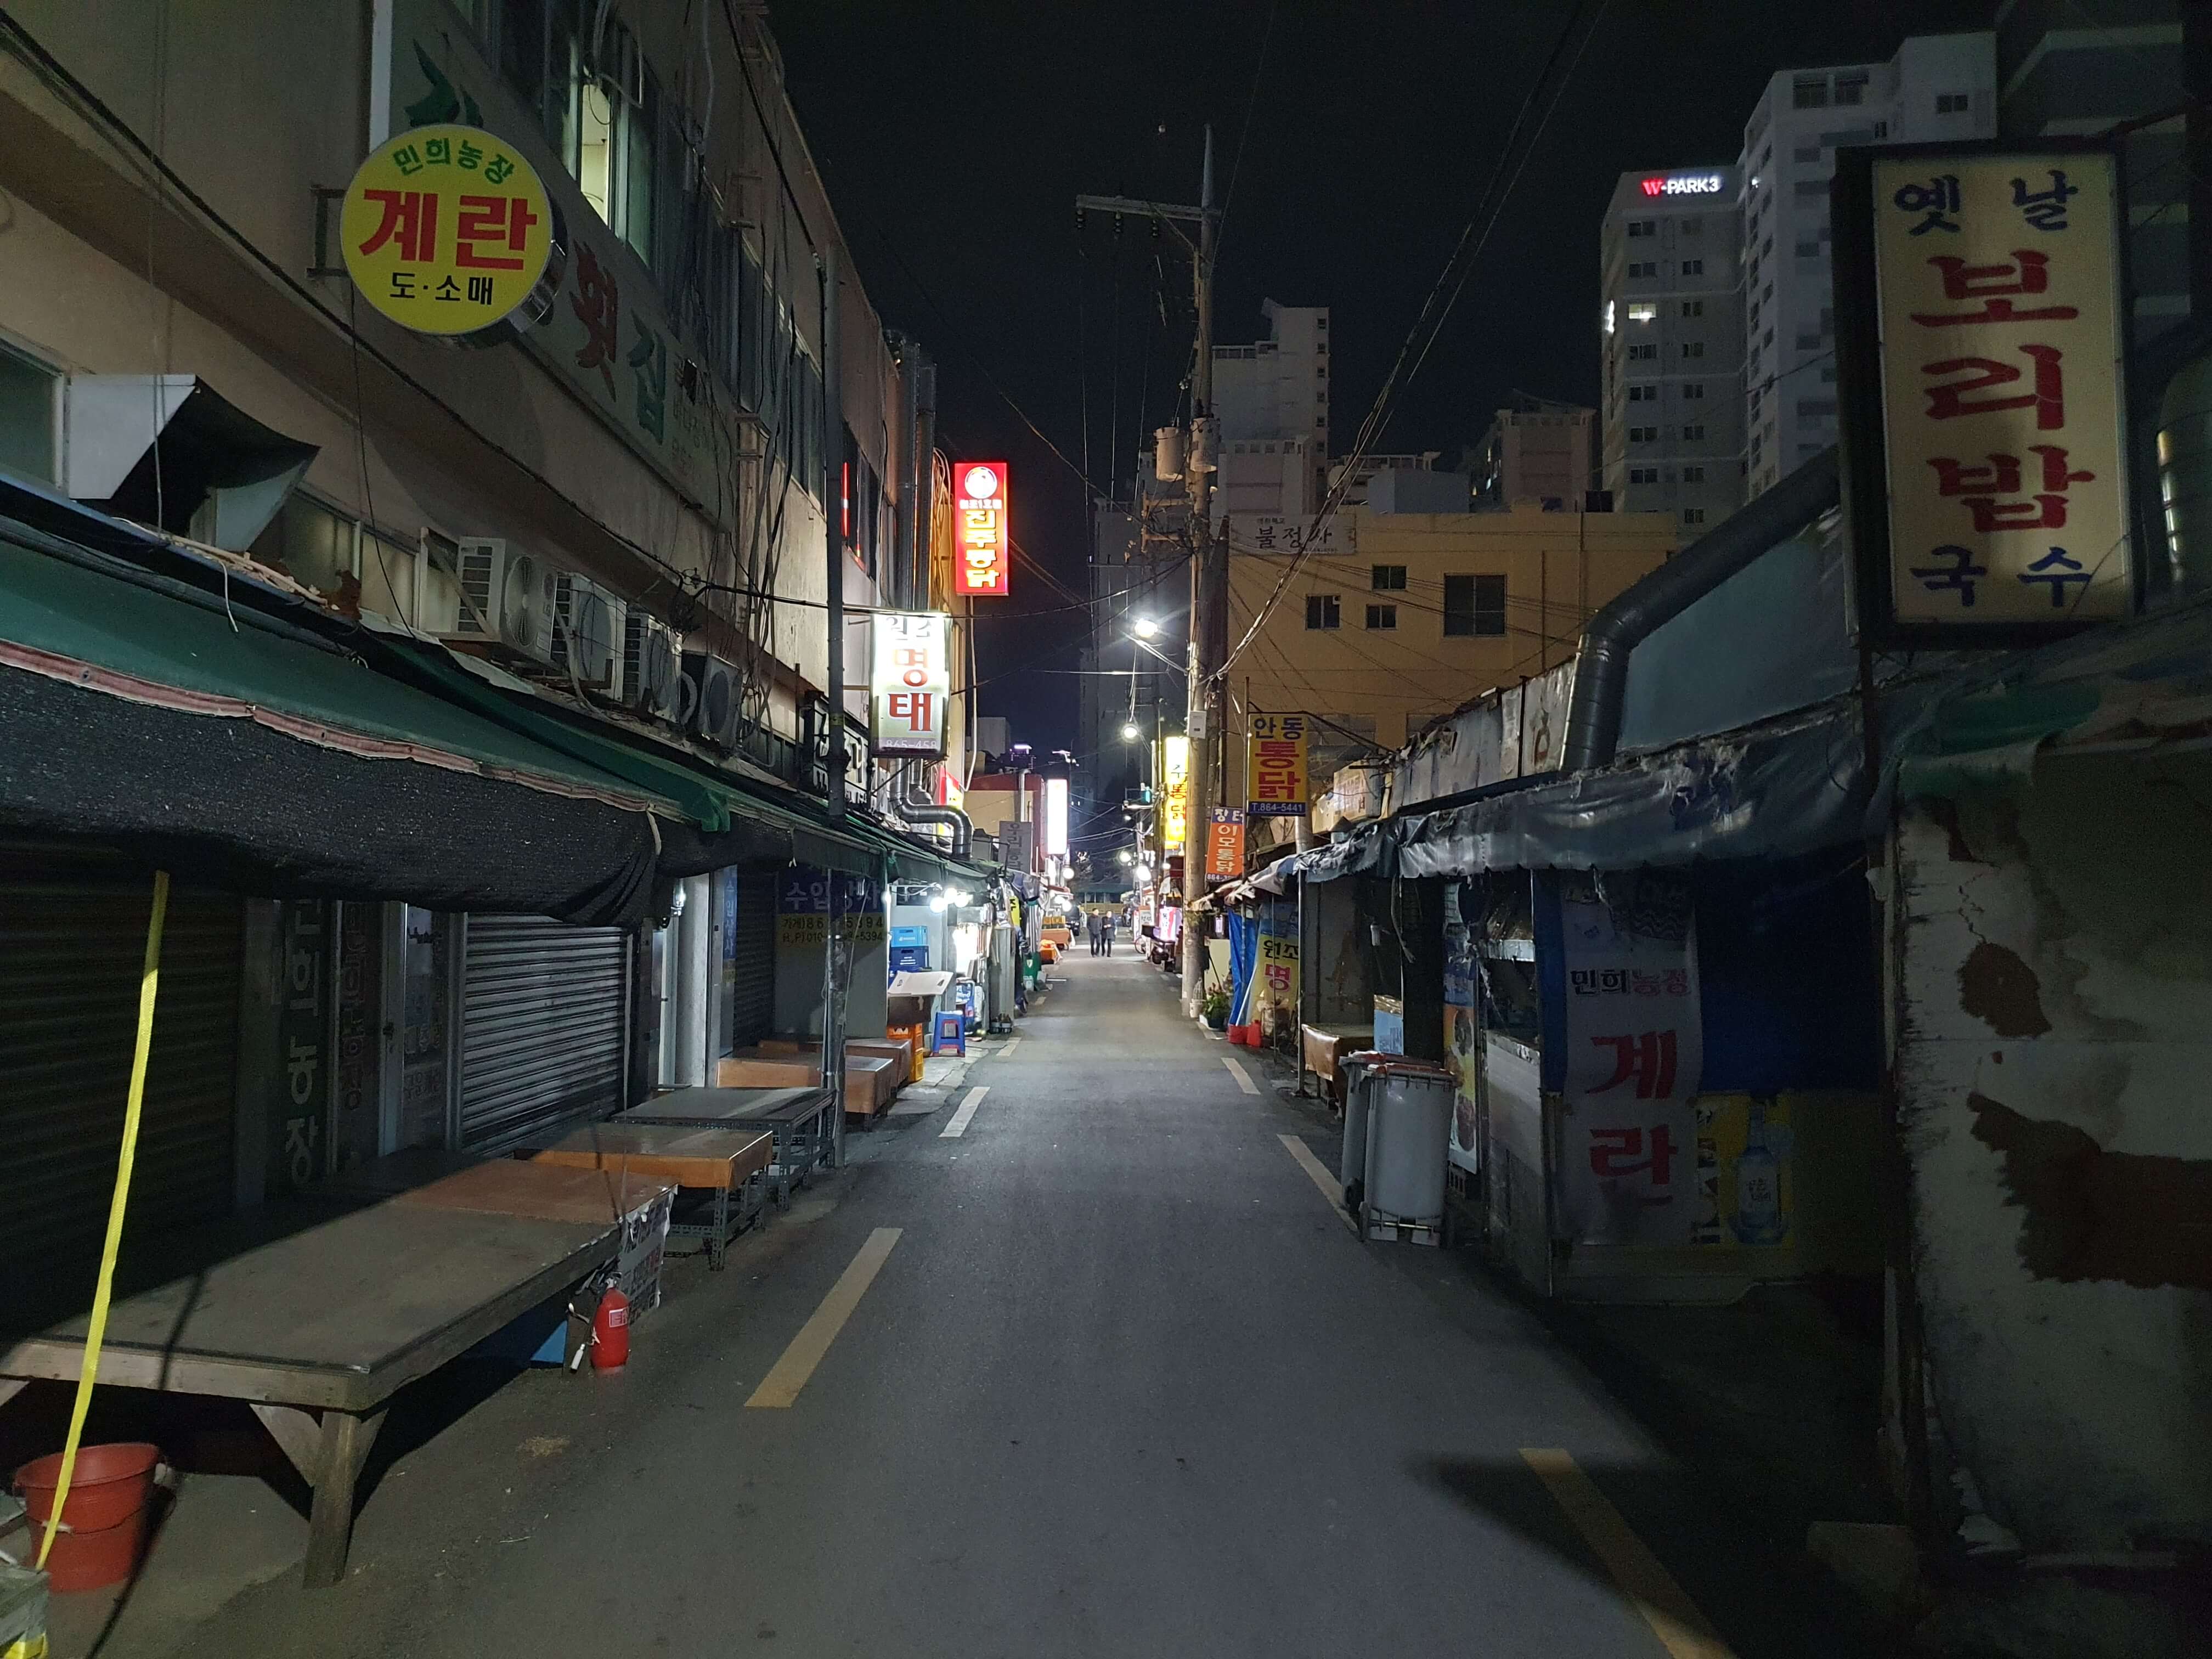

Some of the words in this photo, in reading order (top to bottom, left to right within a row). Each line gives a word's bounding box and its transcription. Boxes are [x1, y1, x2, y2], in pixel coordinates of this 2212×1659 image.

[393, 138, 515, 184] 민희농장
[1642, 176, 1719, 195] W-PARK3
[1894, 170, 2078, 235] 옛날
[359, 189, 537, 270] 계란
[1910, 250, 2095, 532] 보리밥
[965, 510, 1000, 588] 진주통닭
[1255, 526, 1332, 549] 불정사
[1909, 545, 2092, 607] 국수
[888, 648, 933, 732] 명태
[1254, 717, 1305, 740] 안동
[1255, 742, 1301, 800] 통닭
[1214, 808, 1244, 822] 장터
[1251, 803, 1303, 812] T.864-5441
[1216, 825, 1238, 873] 이모통닭
[1570, 969, 1689, 996] 민희농장
